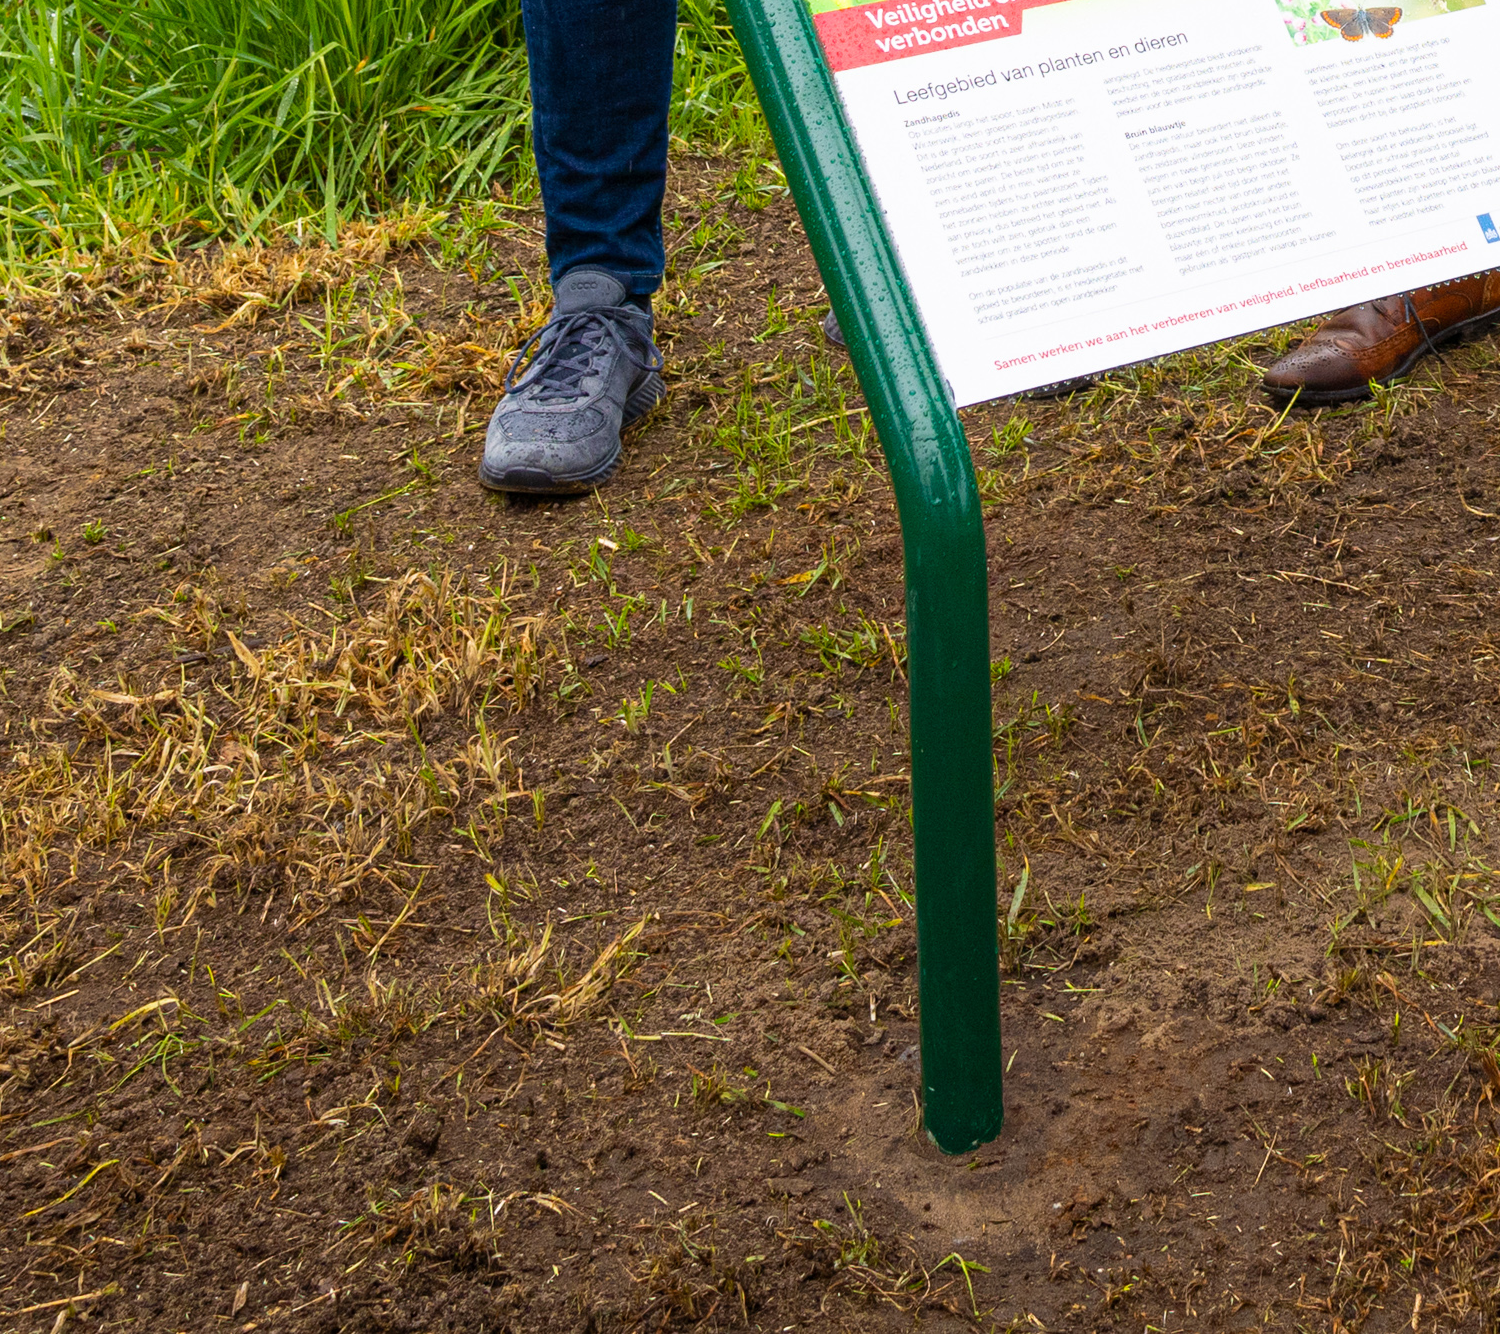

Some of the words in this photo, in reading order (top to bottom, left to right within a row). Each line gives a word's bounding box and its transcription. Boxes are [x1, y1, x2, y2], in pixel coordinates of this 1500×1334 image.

[874, 12, 1010, 55] verbonden
[893, 69, 999, 105] Leefgebied
[1000, 65, 1034, 82] van
[1037, 50, 1104, 77] planten
[1107, 44, 1130, 59] en
[1131, 32, 1189, 54] dieren
[902, 109, 961, 128] Zandhagedis
[1123, 128, 1148, 139] Bruin
[1147, 119, 1187, 134] blauwtje
[993, 353, 1037, 371] Samen
[1038, 341, 1084, 360] werken
[1085, 336, 1104, 348] we
[1105, 330, 1128, 343] aan
[1128, 322, 1149, 336] het
[1151, 308, 1215, 331] verbeteren
[1215, 302, 1238, 314] van
[1239, 284, 1298, 308] veiligheid,
[1298, 265, 1369, 292] leefbaarheid
[1370, 264, 1385, 274] en
[1385, 240, 1468, 270] bereikbaarheid
